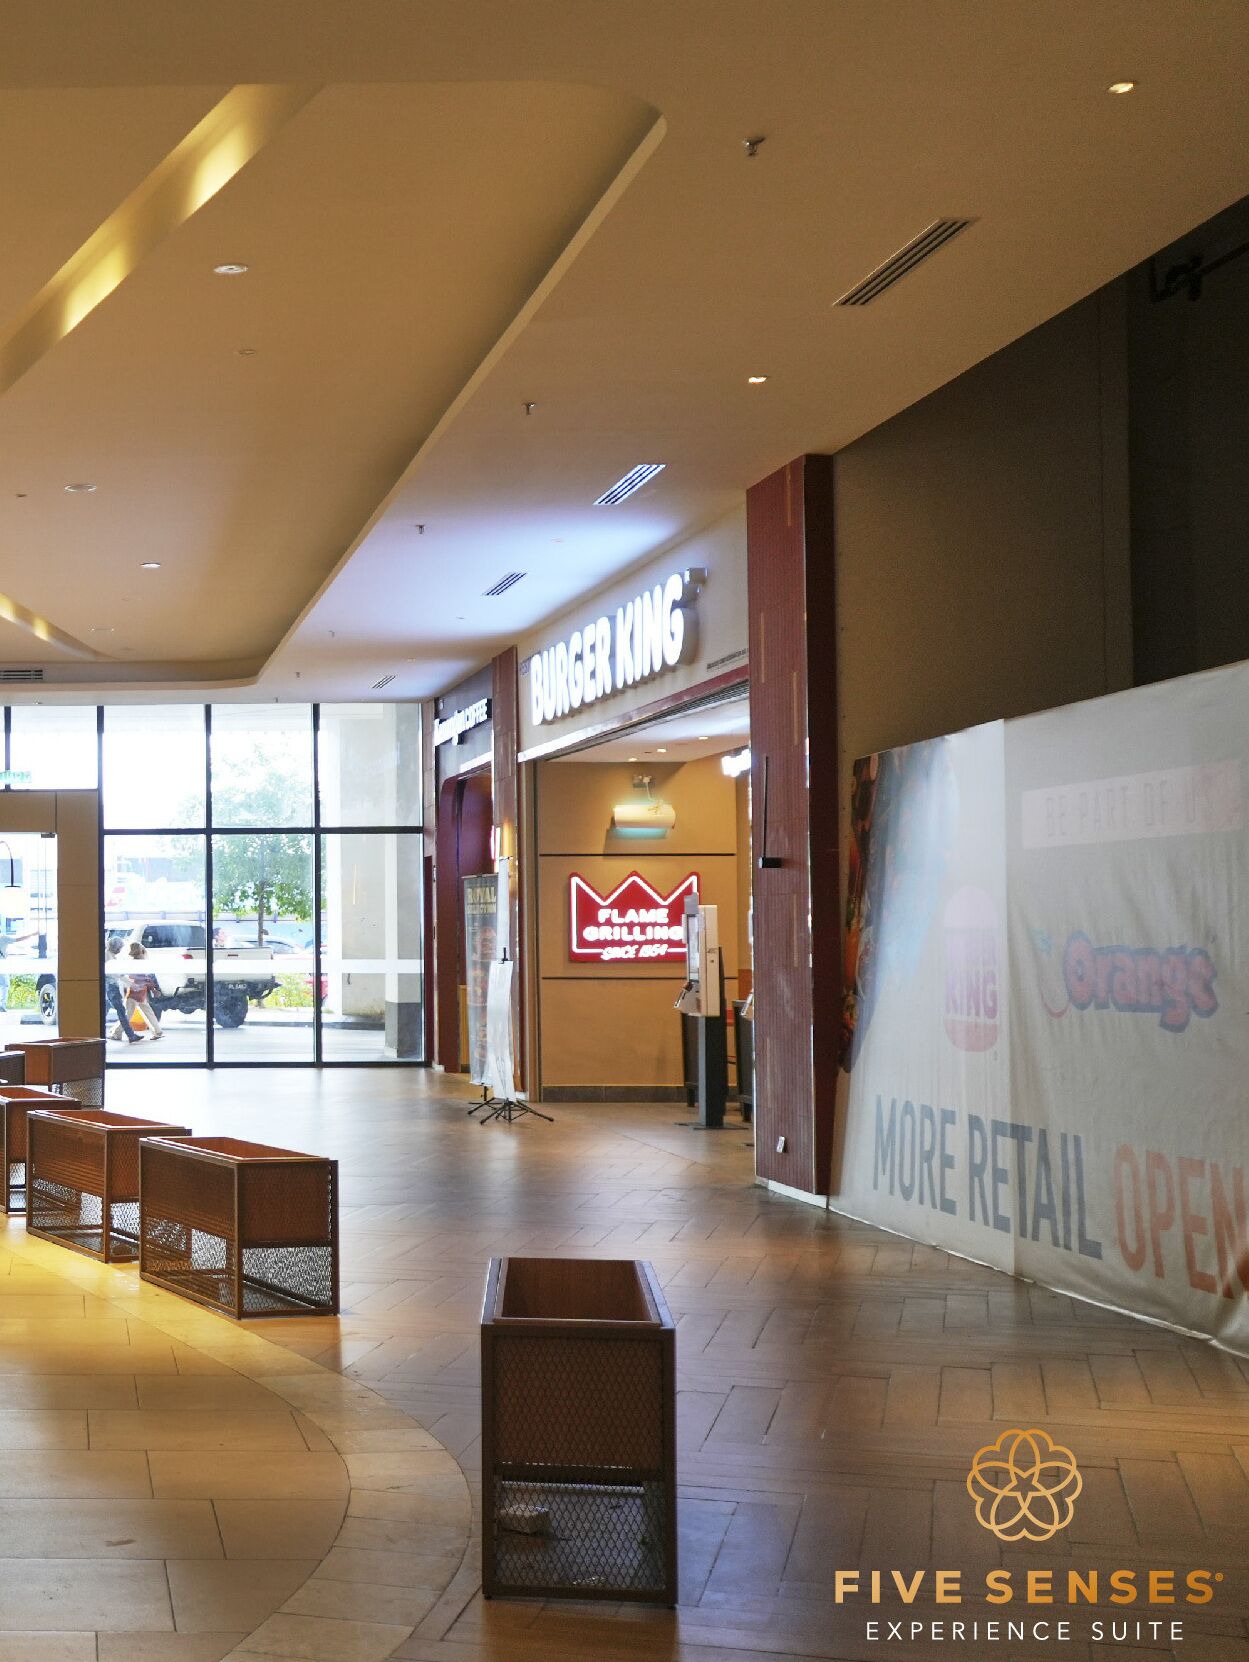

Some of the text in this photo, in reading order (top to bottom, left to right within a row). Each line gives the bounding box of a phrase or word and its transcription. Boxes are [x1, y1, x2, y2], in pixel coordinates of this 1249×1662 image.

[530, 573, 685, 726] BURGER KING
[465, 698, 488, 730] COFFEE
[1046, 794, 1068, 838] BE
[1143, 779, 1168, 827] OF
[467, 886, 497, 903] ROYAL
[597, 907, 669, 924] FLAME
[582, 925, 684, 942] GRILLING
[600, 944, 639, 961] SINCE
[945, 969, 998, 1021] KING
[873, 1094, 957, 1217] MORE
[967, 1113, 1103, 1260] RETAIL
